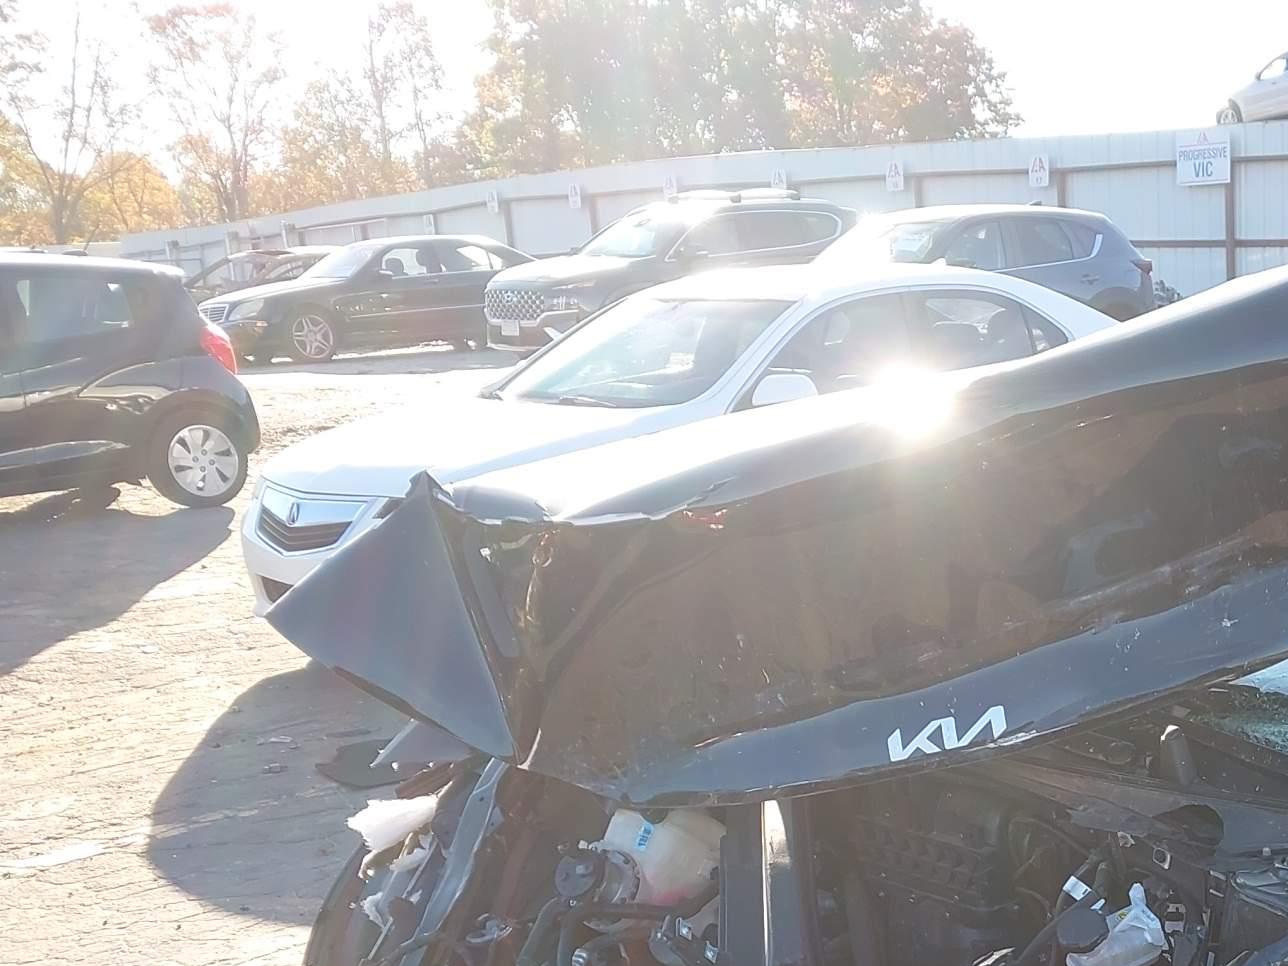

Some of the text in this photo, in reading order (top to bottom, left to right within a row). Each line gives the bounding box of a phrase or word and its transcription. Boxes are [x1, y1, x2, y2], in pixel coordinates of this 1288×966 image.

[1178, 145, 1228, 161] PROGRESSIVE
[1192, 160, 1214, 178] VIC
[886, 704, 1008, 762] KIA
